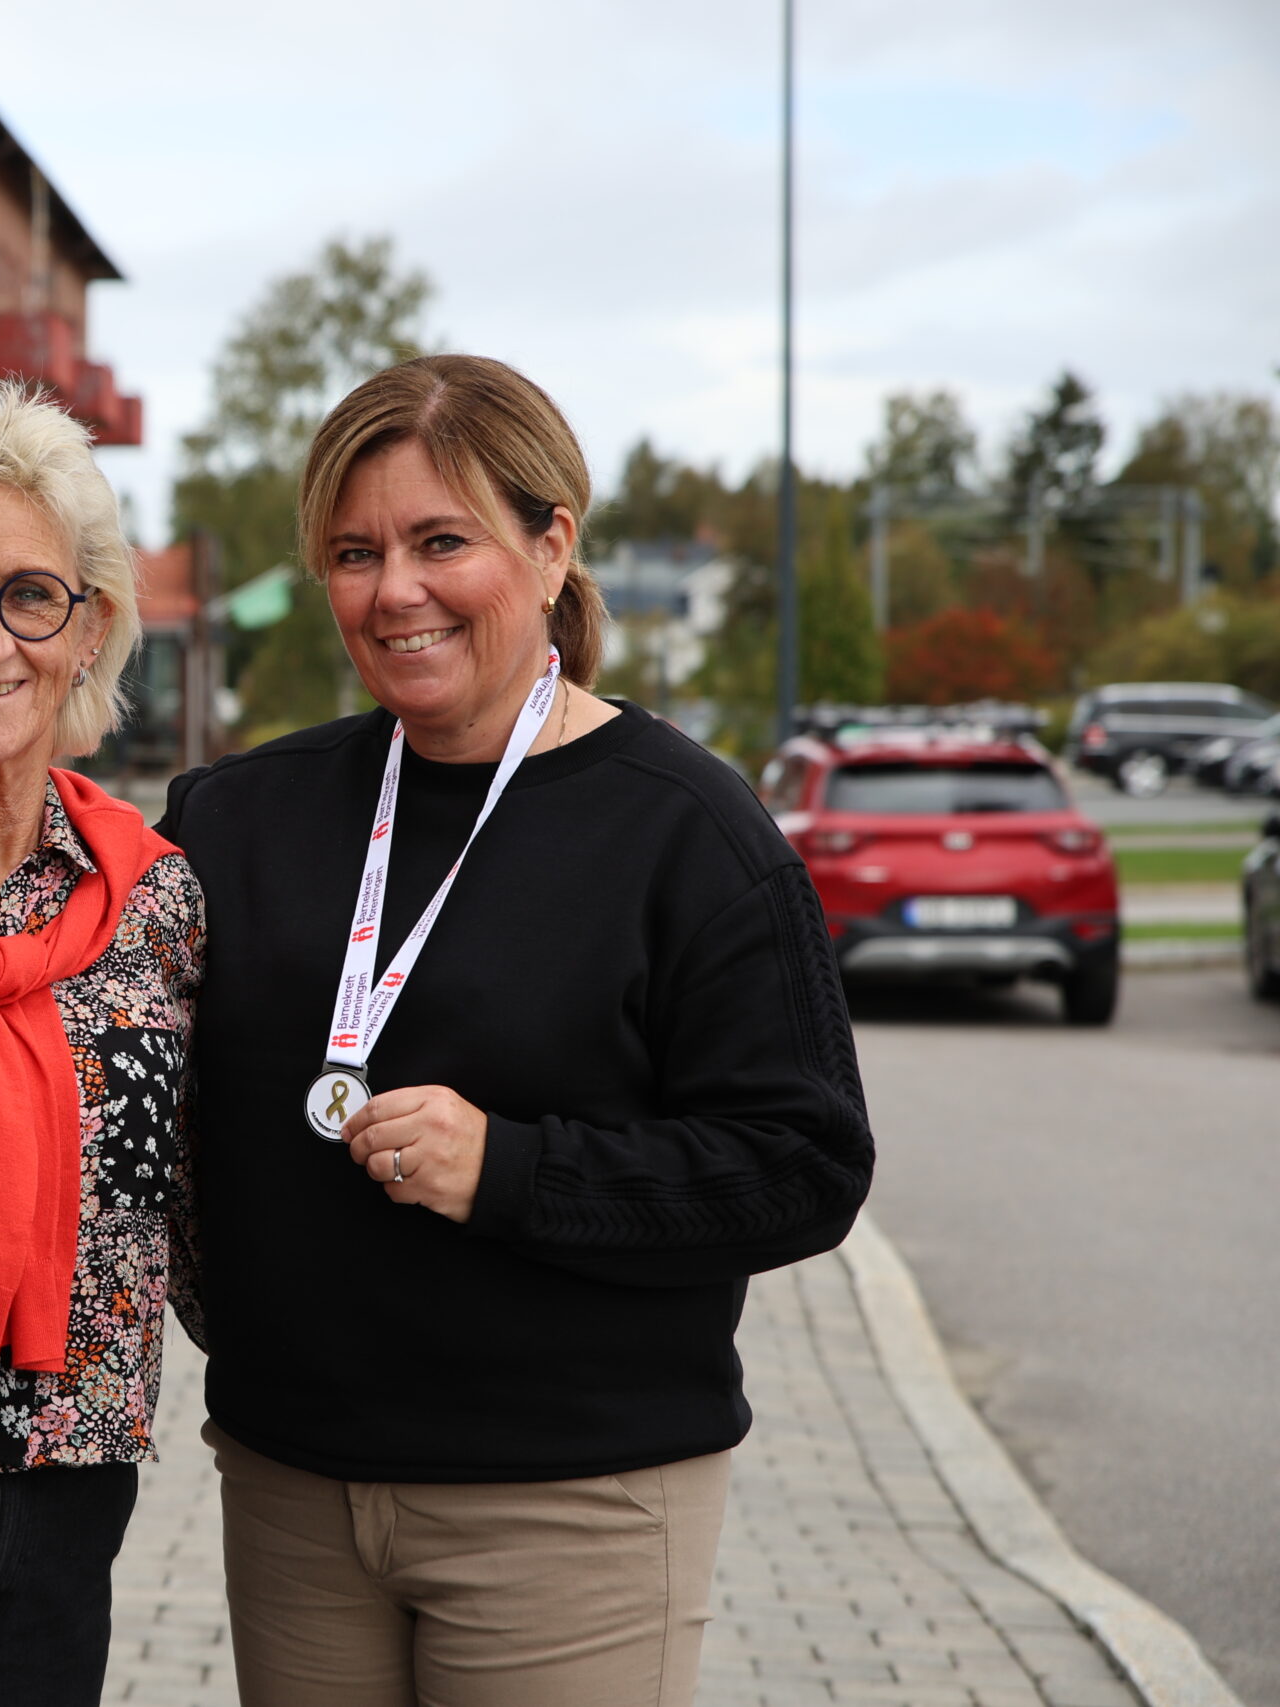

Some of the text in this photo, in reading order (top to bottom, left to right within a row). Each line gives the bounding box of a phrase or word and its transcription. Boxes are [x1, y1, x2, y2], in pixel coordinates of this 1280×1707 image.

[356, 870, 375, 925] Barnekreft
[366, 865, 384, 922] foreningen
[337, 974, 357, 1030] Barnekreft
[348, 972, 368, 1030] foreningen
